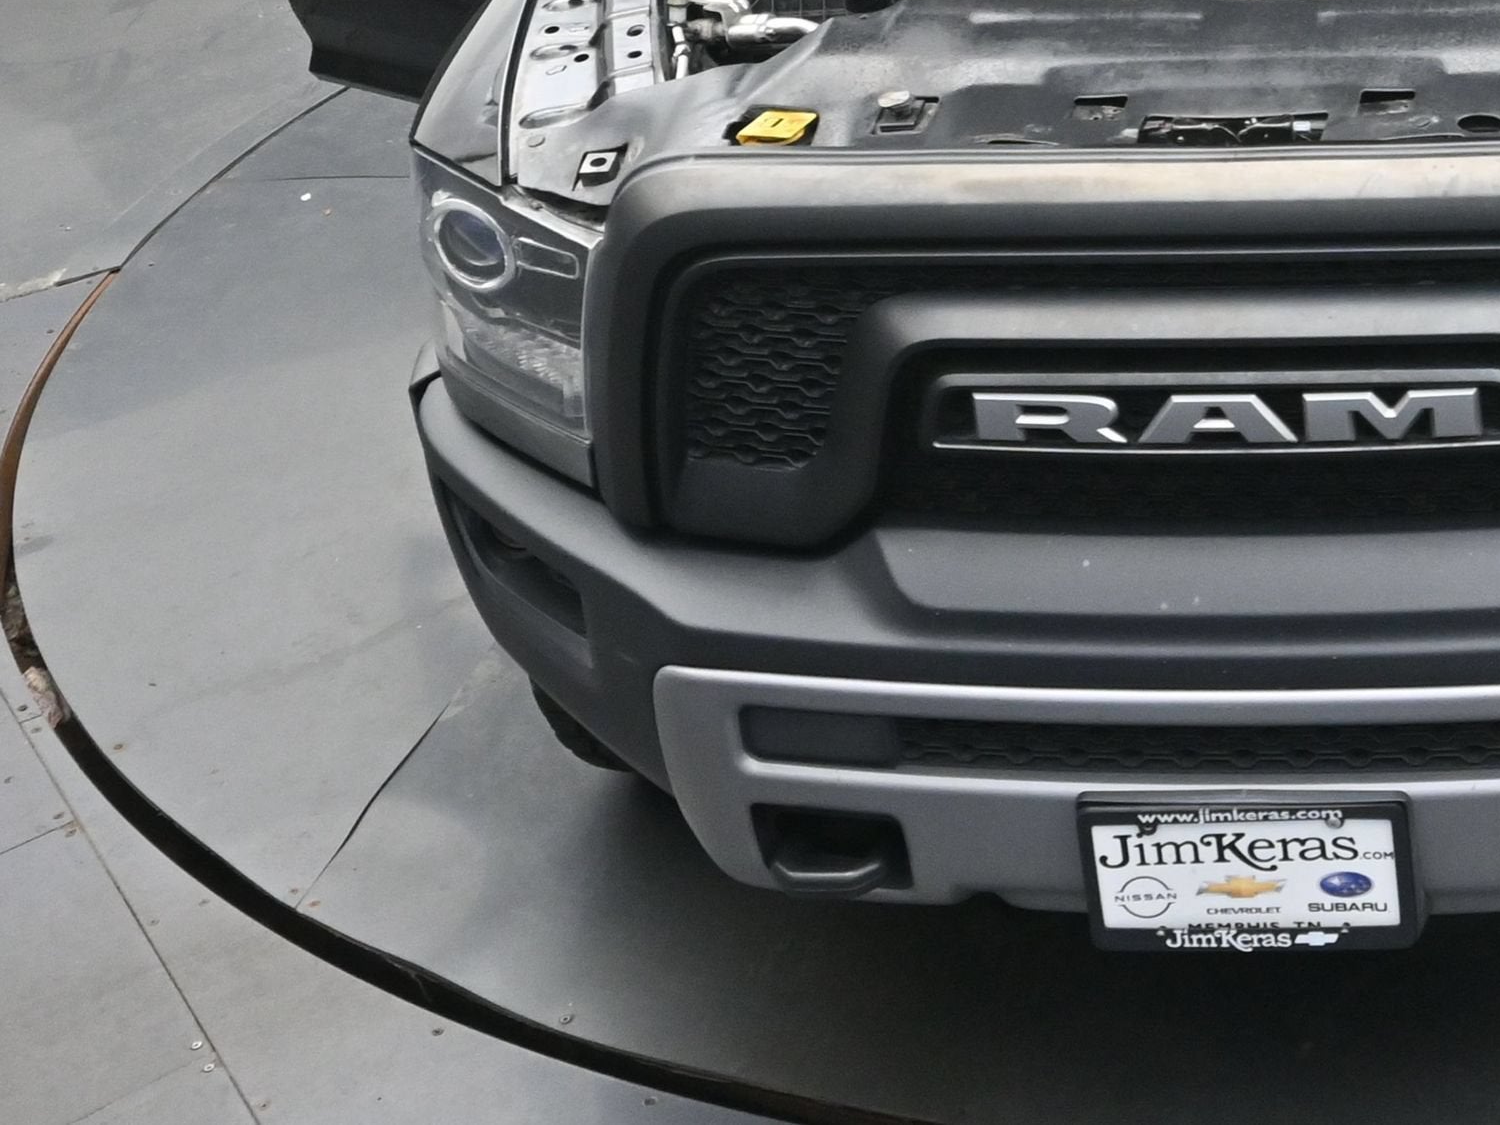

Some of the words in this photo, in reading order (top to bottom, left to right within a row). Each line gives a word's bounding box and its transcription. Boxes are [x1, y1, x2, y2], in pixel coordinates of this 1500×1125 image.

[972, 387, 1485, 444] RAM
[1137, 808, 1343, 824] www.jimkeras.com
[1114, 892, 1178, 903] NISSAN
[1206, 906, 1282, 915] CHEVROLET
[1307, 902, 1388, 913] SUBARU
